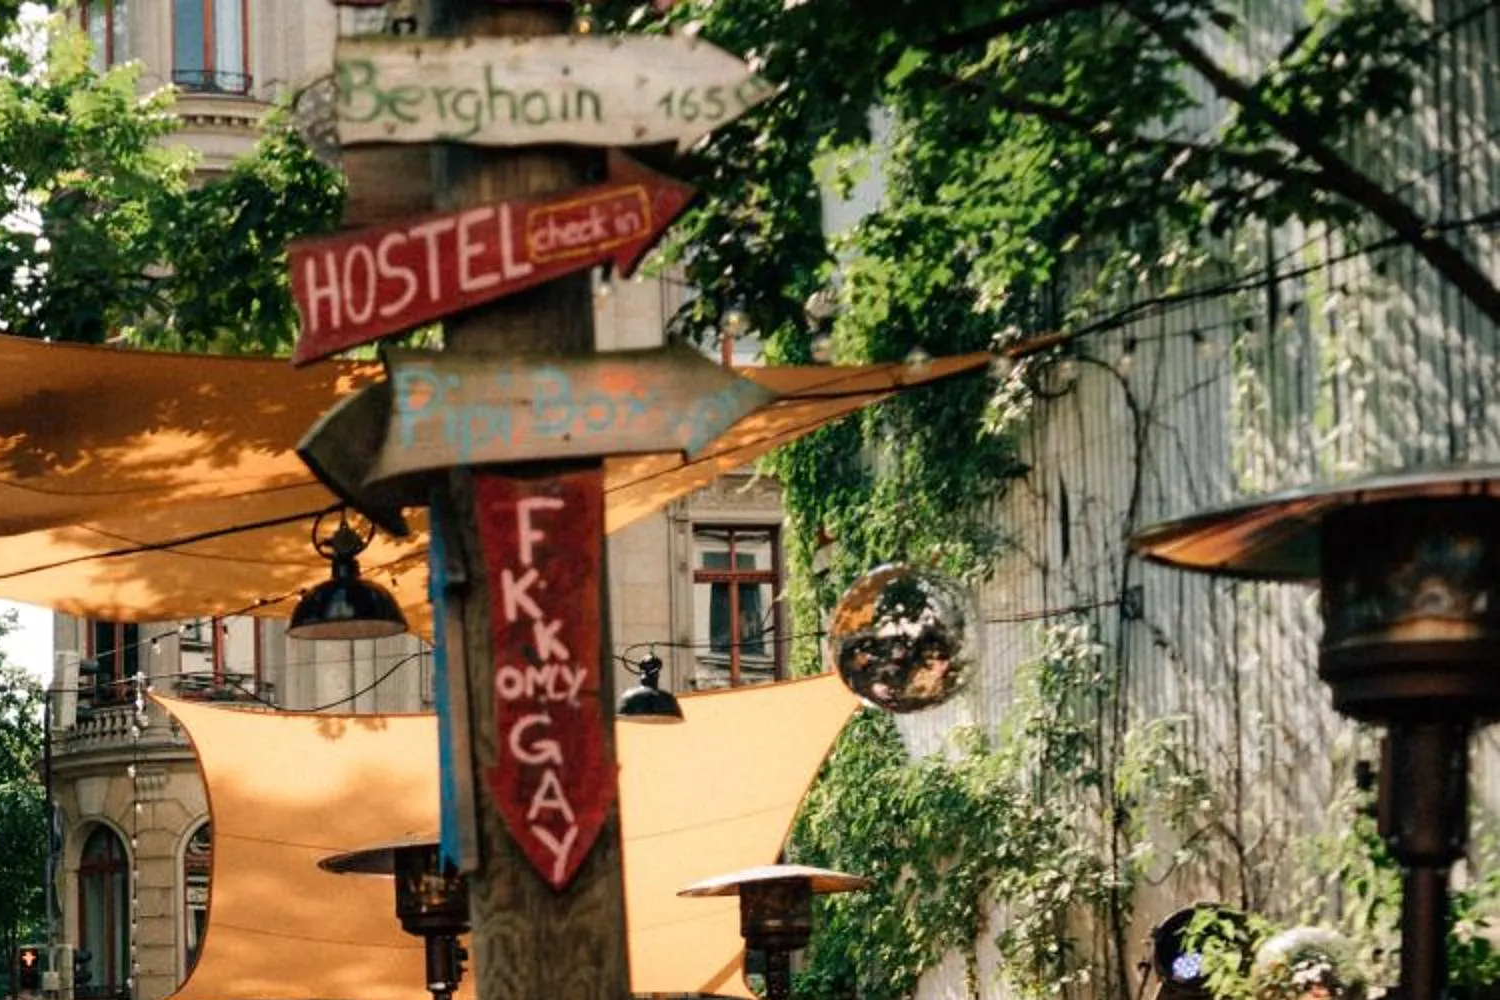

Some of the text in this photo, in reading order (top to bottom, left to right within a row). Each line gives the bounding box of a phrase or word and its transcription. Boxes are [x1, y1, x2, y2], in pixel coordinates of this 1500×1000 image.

[337, 60, 603, 141] Berghain
[304, 201, 643, 334] HOSTEL check in
[500, 496, 569, 660] FKK
[508, 713, 579, 885] GAY
